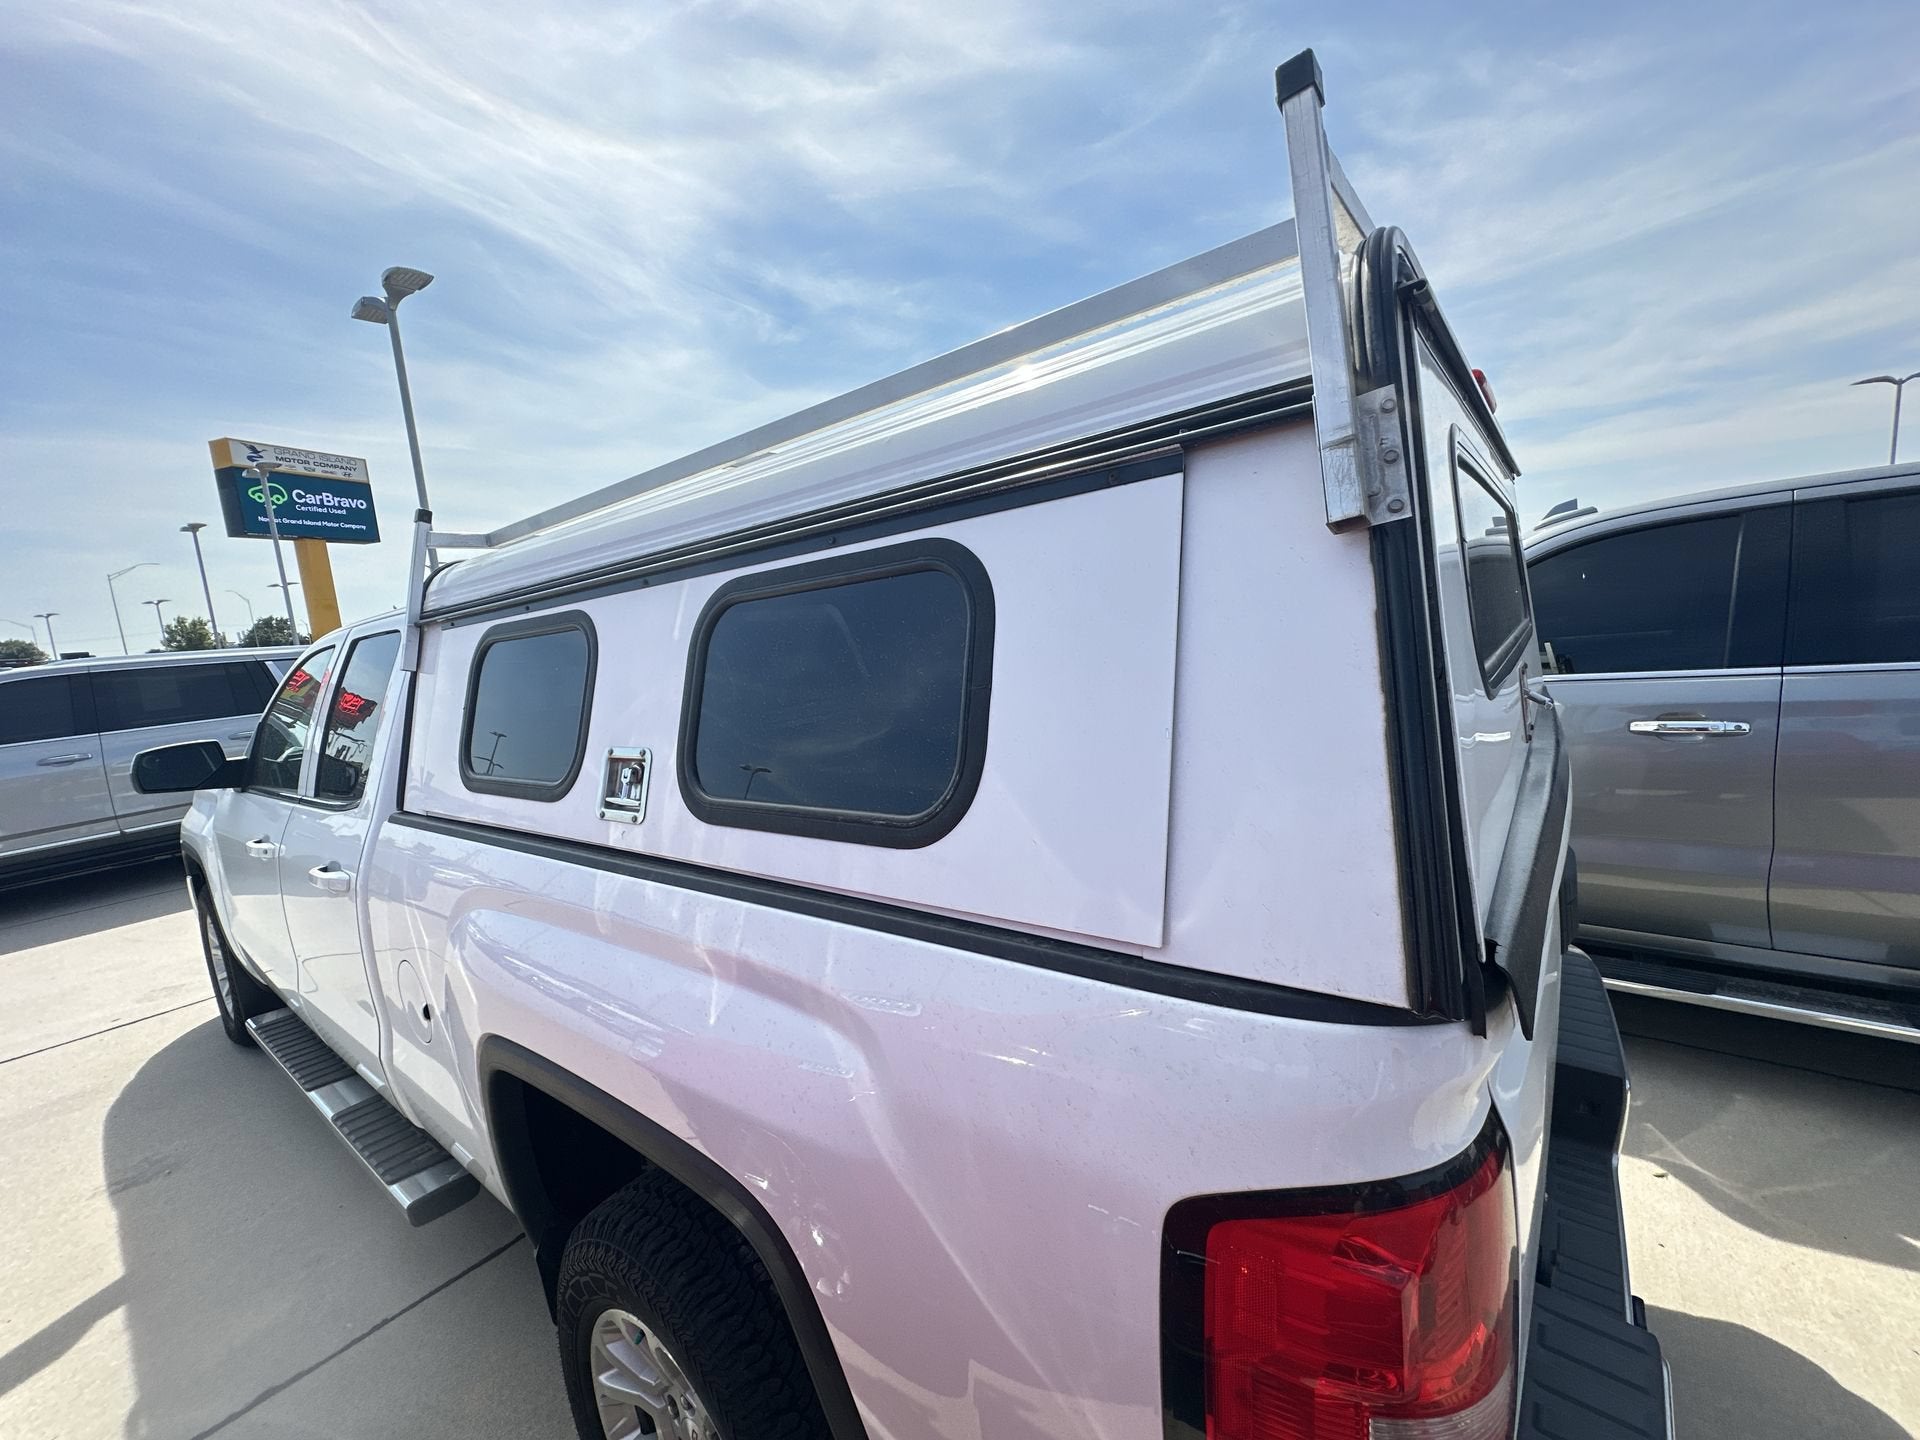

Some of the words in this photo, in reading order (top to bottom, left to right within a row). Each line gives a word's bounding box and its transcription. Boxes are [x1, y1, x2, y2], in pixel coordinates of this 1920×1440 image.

[274, 447, 315, 460] GRAND
[319, 455, 357, 466] ISLAND
[275, 456, 311, 466] MOTOR
[313, 461, 357, 472] COMPANY
[292, 489, 367, 509] CarBravo
[295, 504, 327, 513] Certified
[282, 517, 302, 525] Grand
[340, 522, 366, 530] Company
